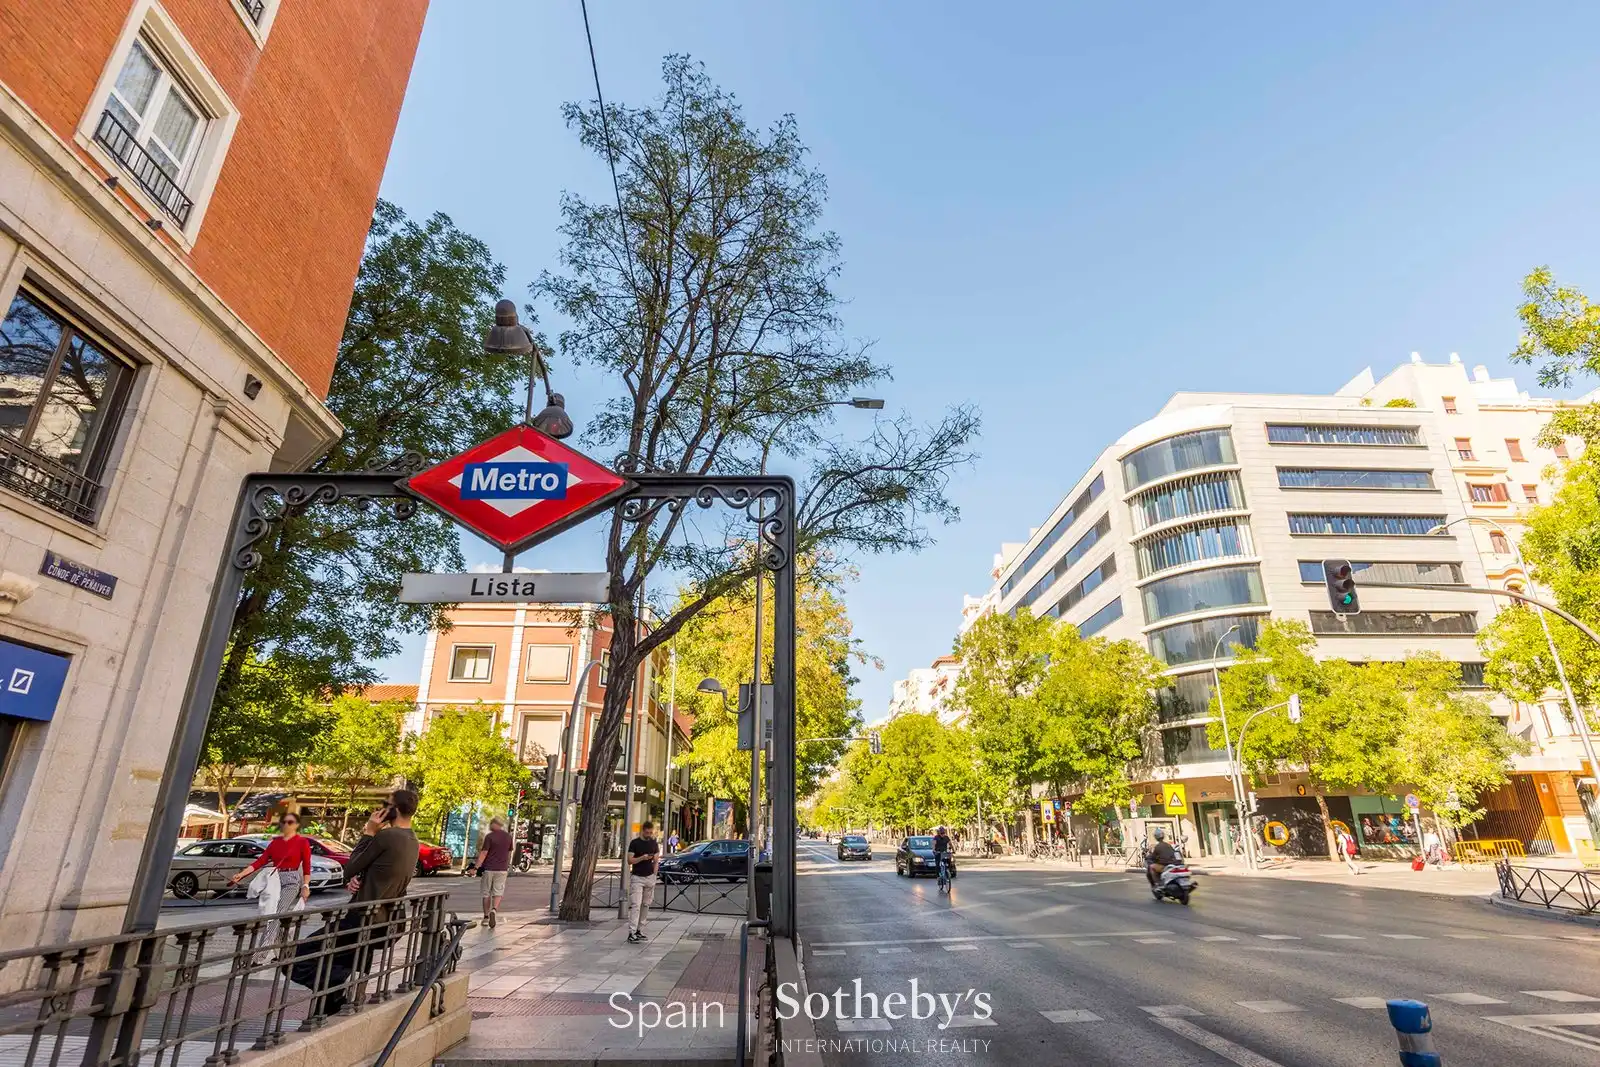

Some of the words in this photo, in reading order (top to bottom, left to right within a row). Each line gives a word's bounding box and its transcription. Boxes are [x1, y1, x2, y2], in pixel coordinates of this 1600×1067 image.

[471, 468, 559, 491] Metro
[47, 564, 70, 580] CONDE
[70, 573, 80, 585] DE
[470, 578, 535, 596] Lista
